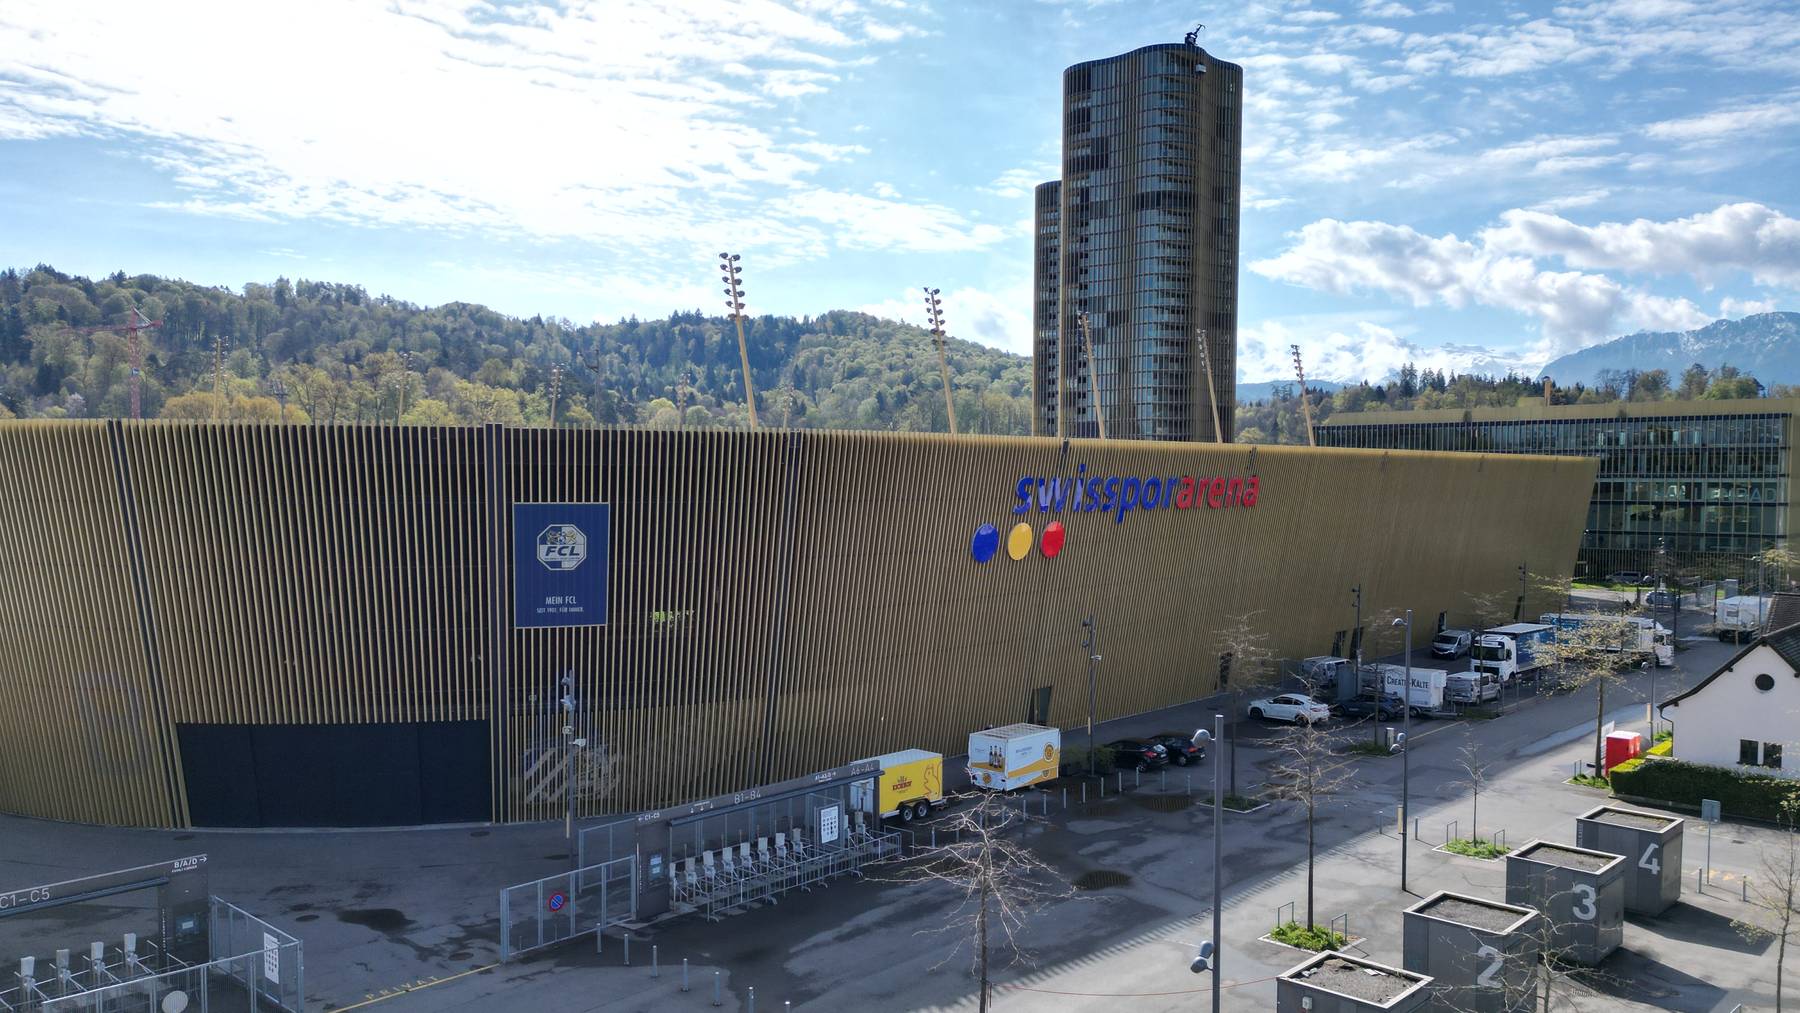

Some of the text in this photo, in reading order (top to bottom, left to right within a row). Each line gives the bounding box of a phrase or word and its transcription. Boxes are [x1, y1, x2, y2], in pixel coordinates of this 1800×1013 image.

[1012, 463, 1260, 525] swissporarena
[545, 545, 580, 557] FCL
[545, 595, 577, 605] MEIN FCL
[734, 788, 761, 804] B1-B4
[174, 857, 198, 869] B/A/D
[1638, 842, 1661, 875] 4
[1572, 883, 1597, 921] 3
[1477, 944, 1505, 989] 2
